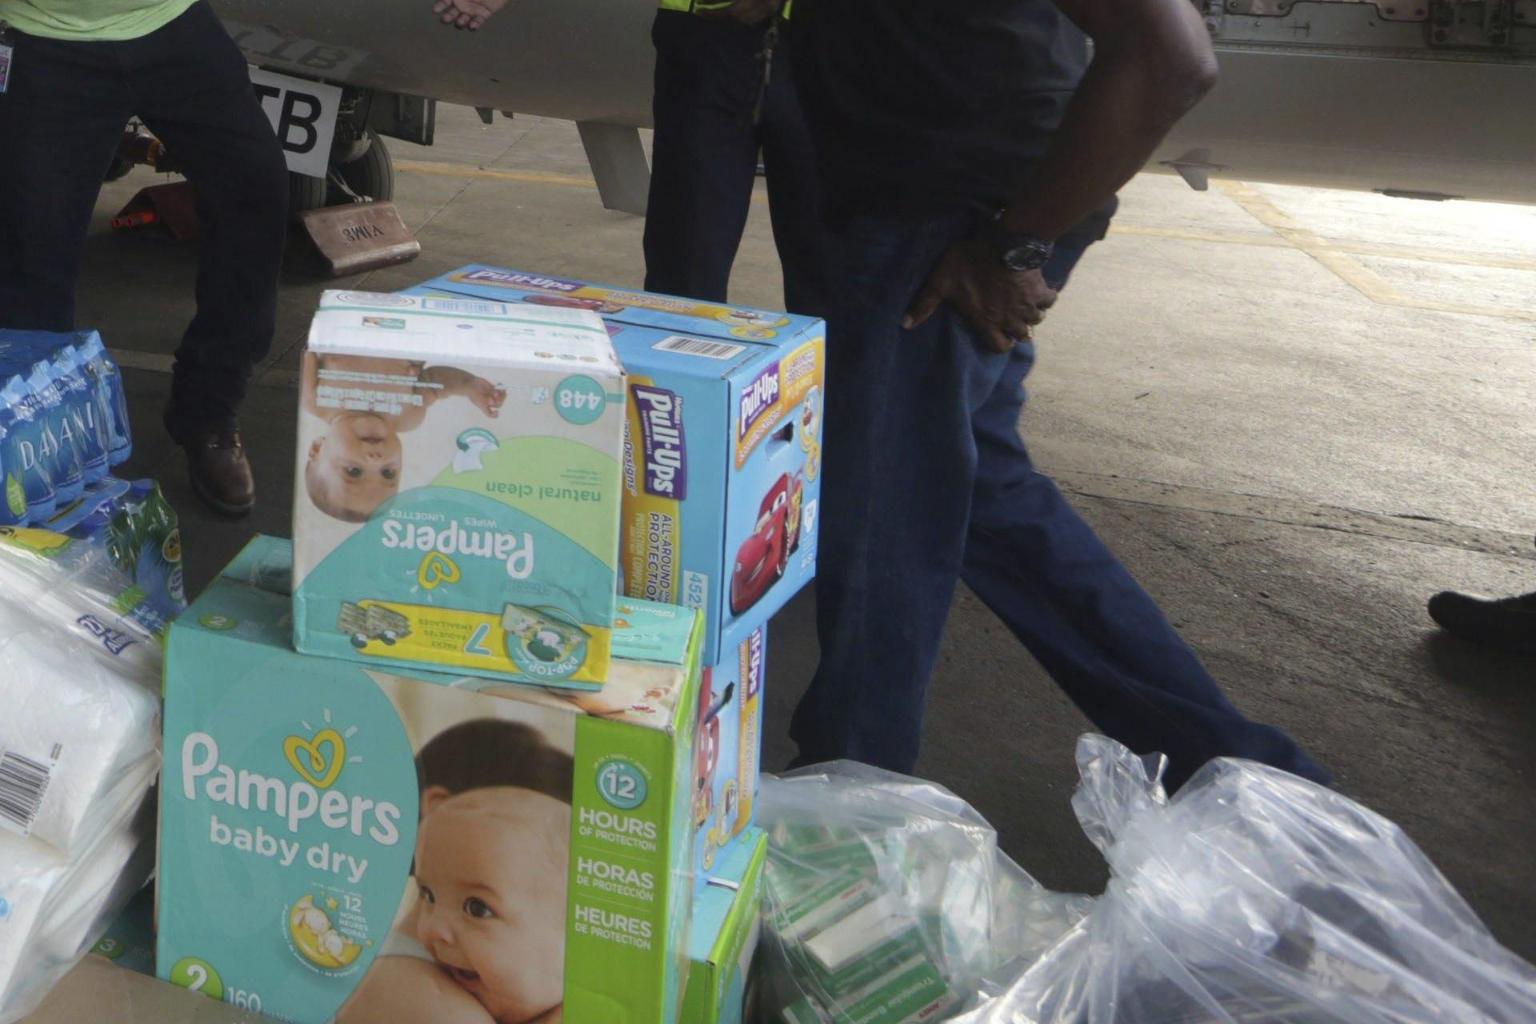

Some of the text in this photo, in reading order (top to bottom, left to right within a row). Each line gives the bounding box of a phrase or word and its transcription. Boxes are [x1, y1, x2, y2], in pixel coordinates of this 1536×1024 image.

[559, 389, 602, 411] 448
[20, 401, 95, 472] DASANI
[485, 481, 602, 503] natural clean
[389, 509, 445, 522] LINGETTES
[465, 517, 497, 528] WIPES
[382, 519, 534, 580] Pampers
[661, 514, 673, 590] ALL-AROUND
[465, 624, 493, 656] 7
[529, 655, 578, 676] POP-TOP
[181, 731, 401, 845] Pampers
[606, 772, 636, 800] 12
[579, 807, 657, 840] HOURS
[210, 815, 368, 883] baby dry
[578, 826, 657, 852] OF PROTECTION
[576, 875, 590, 886] DE
[577, 856, 654, 890] HORAS
[343, 895, 362, 913] 12
[574, 904, 652, 938] HEURES
[574, 923, 651, 951] DE PROTECTION
[187, 964, 208, 991] 2
[227, 986, 261, 1013] 160
